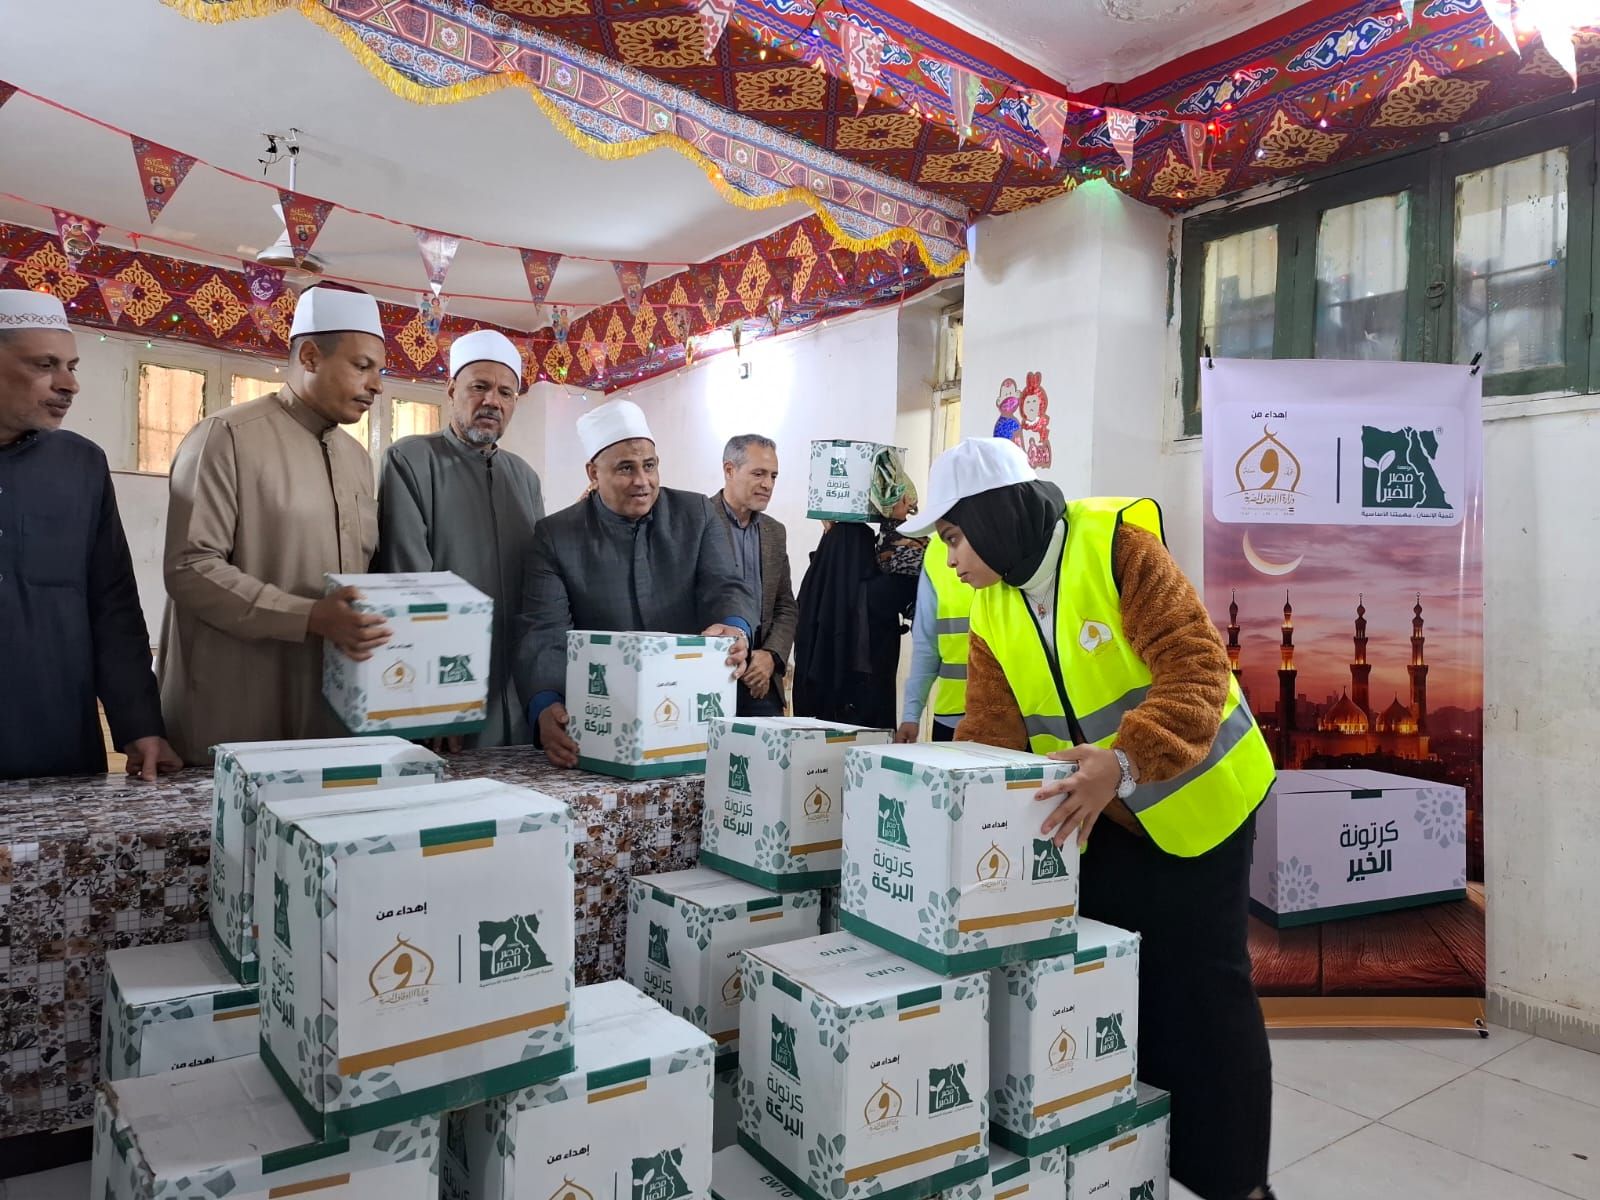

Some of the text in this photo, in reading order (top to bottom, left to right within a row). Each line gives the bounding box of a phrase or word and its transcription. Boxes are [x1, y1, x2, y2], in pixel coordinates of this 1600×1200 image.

[1251, 410, 1287, 420] إهداء من
[1387, 473, 1414, 486] مصر
[826, 490, 850, 499] البركة
[1381, 484, 1413, 503] الخير
[584, 719, 612, 736] البركة
[725, 796, 753, 817] كرتونة
[723, 815, 752, 837] البركة
[1340, 820, 1399, 850] كرتونة
[873, 848, 914, 878] كرتونة
[1346, 849, 1392, 882] الخير
[872, 871, 914, 902] البركة
[376, 901, 427, 921] إهداء من
[495, 955, 521, 974] الخير
[500, 947, 521, 961] مصر
[644, 966, 673, 994] كرتونة
[870, 1055, 900, 1069] إهداء من
[767, 1072, 804, 1114] كرتونة
[766, 1096, 804, 1140] البركة
[547, 1144, 590, 1165] إهداء من
[760, 1175, 793, 1197] EW10
